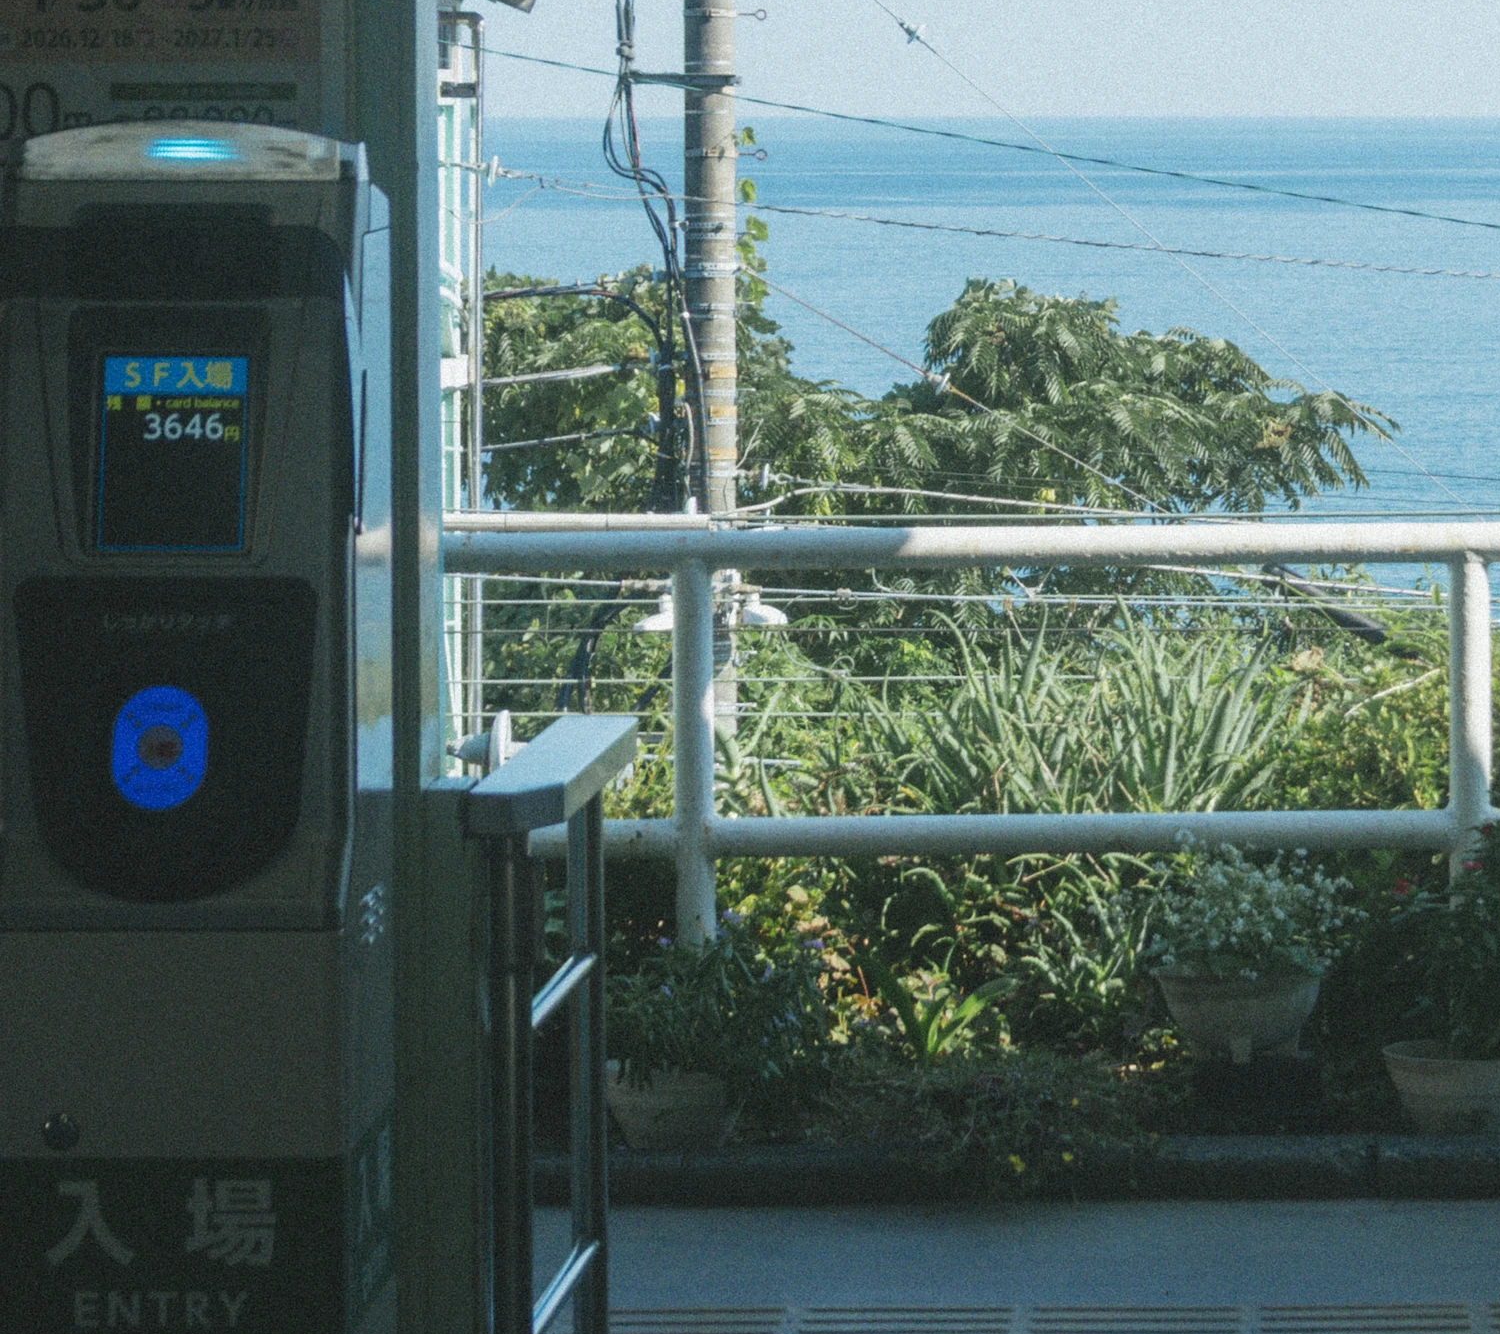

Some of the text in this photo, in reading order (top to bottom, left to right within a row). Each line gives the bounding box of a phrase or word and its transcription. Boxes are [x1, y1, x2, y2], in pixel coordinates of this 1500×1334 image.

[164, 397, 192, 409] card
[193, 397, 241, 409] balance
[45, 1177, 278, 1268] 入場
[73, 1290, 249, 1329] ENTRY
